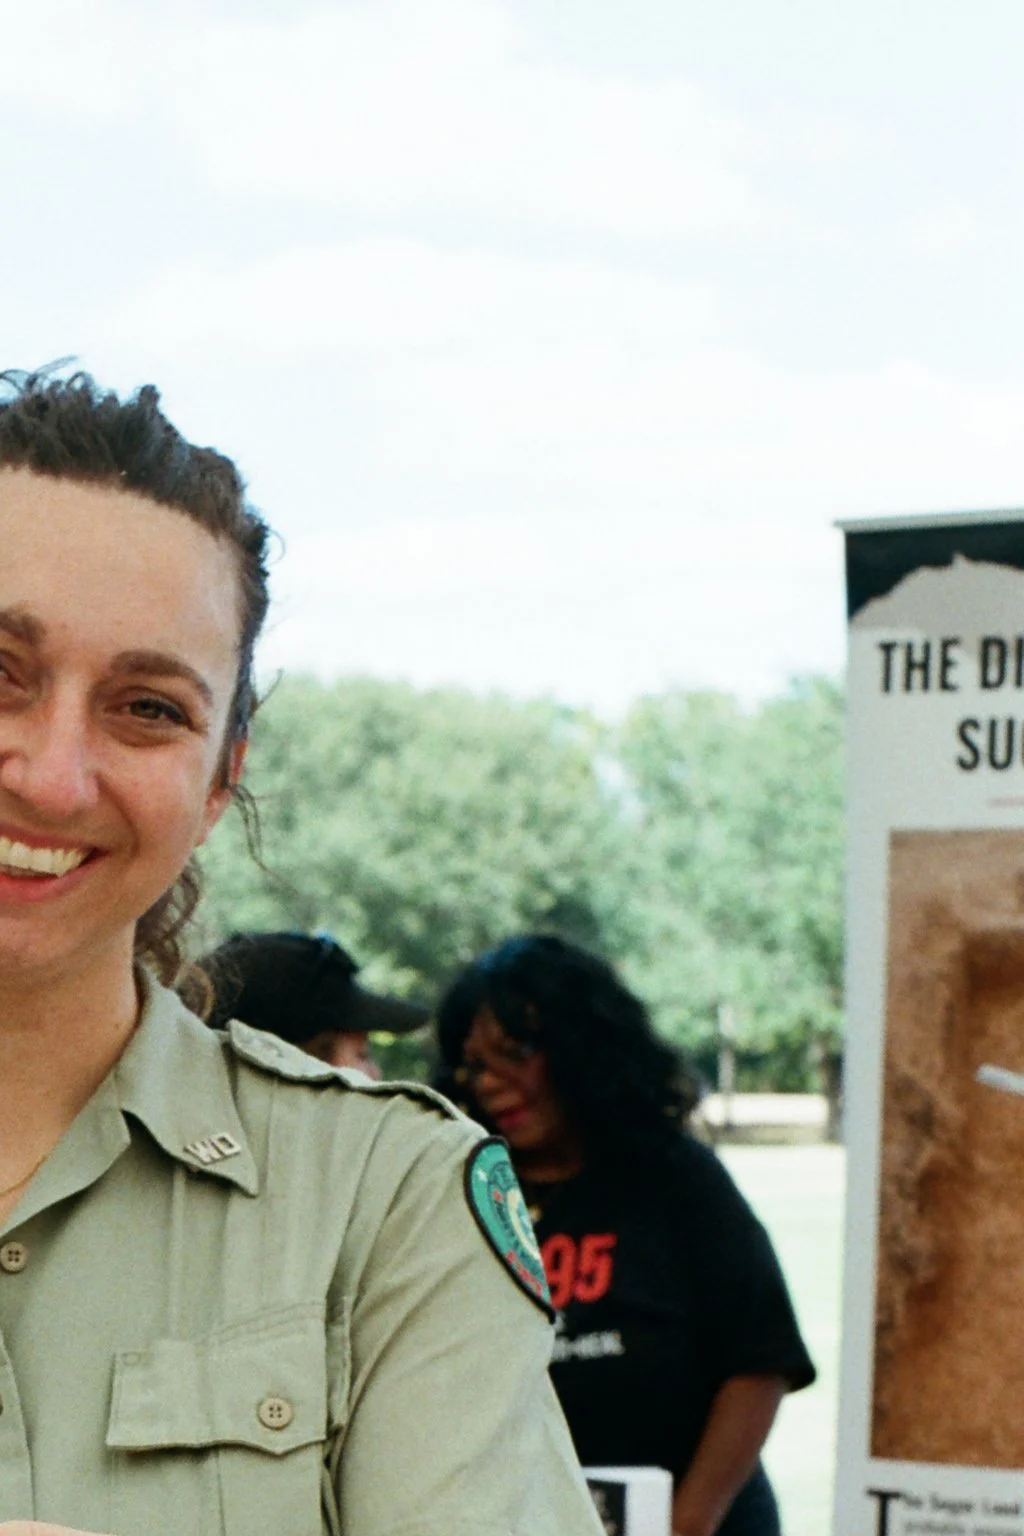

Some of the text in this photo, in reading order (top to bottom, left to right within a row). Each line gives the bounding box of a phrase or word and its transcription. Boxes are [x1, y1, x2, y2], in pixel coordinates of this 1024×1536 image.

[877, 636, 962, 694] THE
[955, 715, 1024, 772] SU
[541, 1231, 618, 1311] 95
